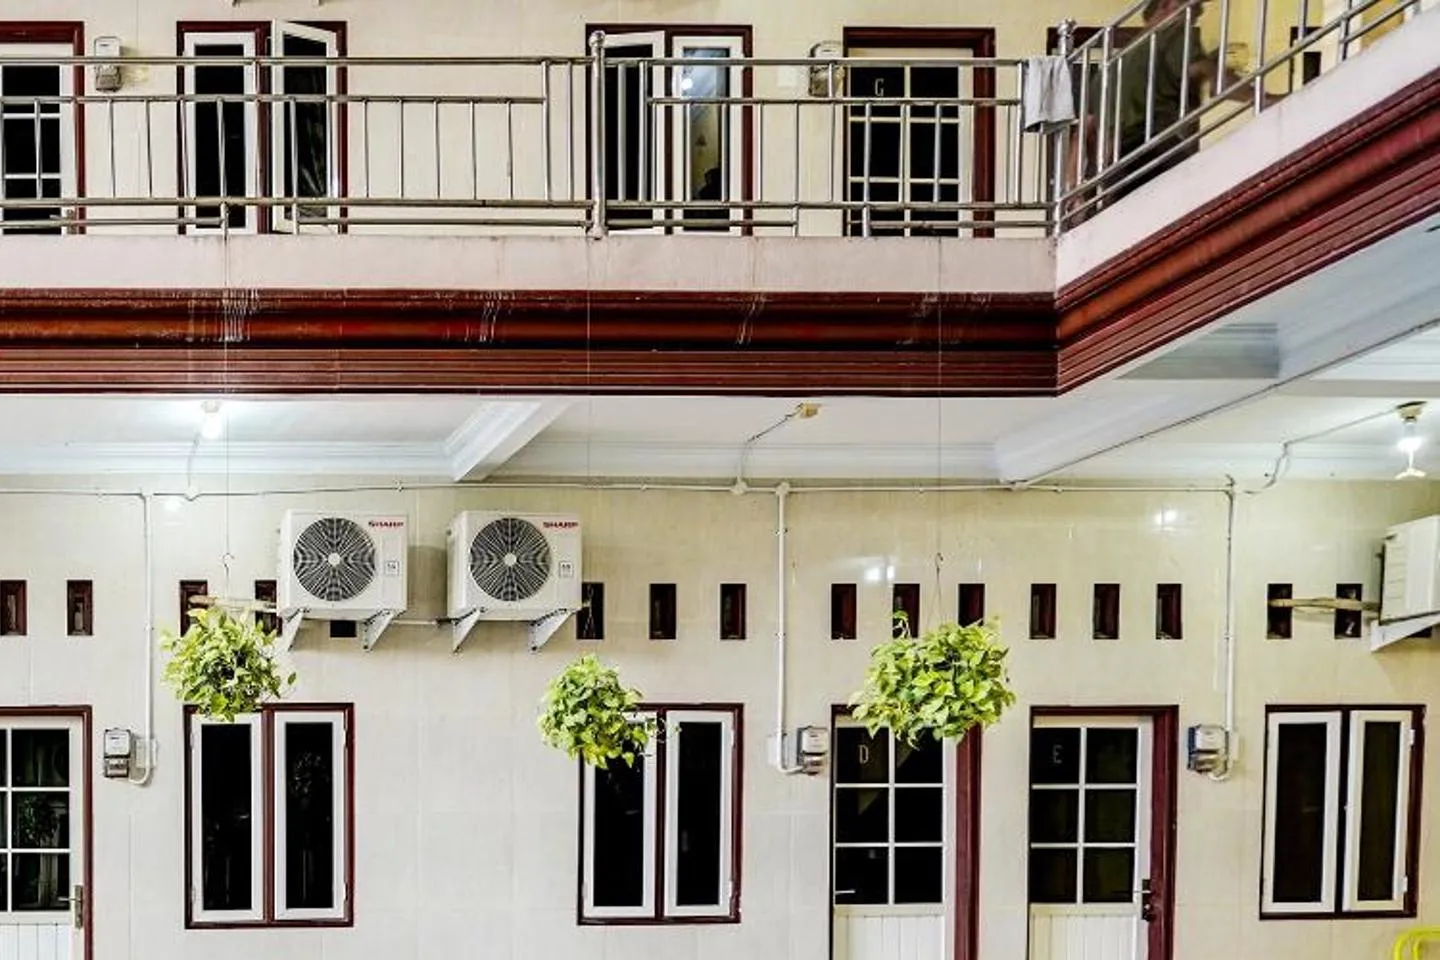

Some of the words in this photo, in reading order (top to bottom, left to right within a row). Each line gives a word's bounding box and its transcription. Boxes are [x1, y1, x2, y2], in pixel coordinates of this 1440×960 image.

[874, 77, 885, 97] G
[858, 744, 869, 765] D
[1052, 743, 1063, 765] E
